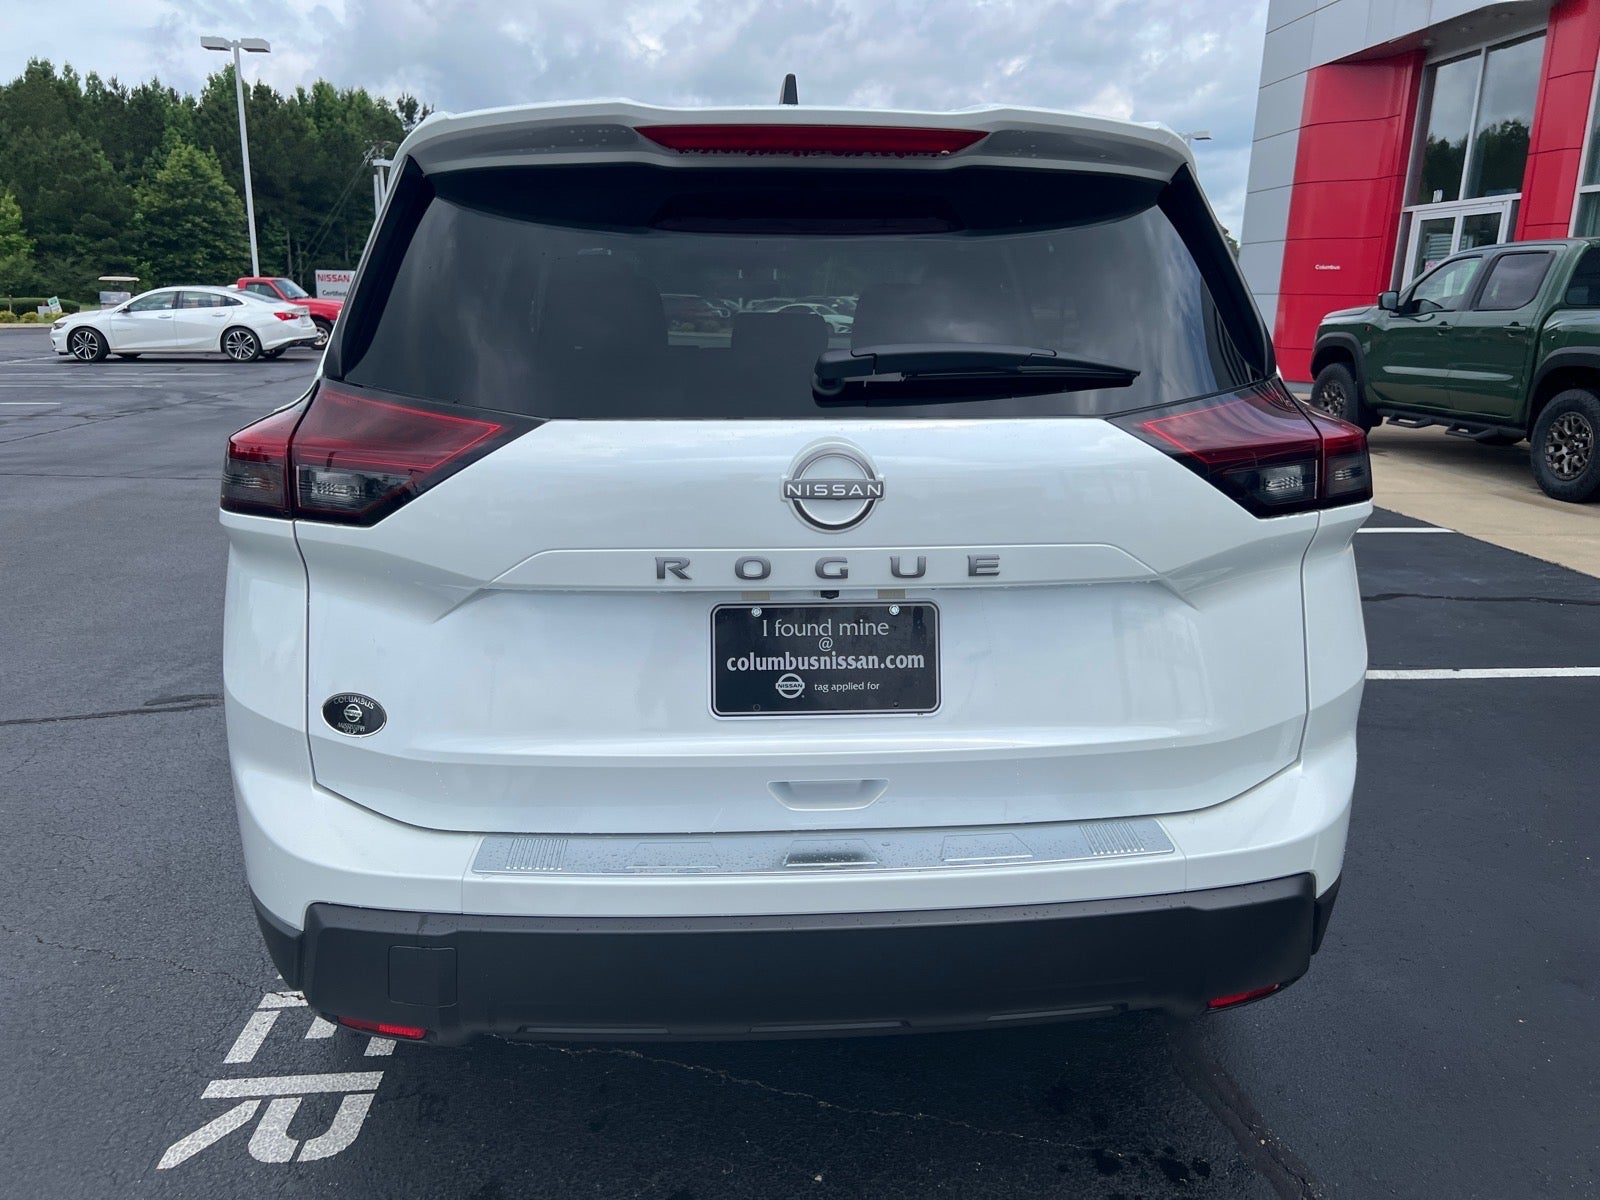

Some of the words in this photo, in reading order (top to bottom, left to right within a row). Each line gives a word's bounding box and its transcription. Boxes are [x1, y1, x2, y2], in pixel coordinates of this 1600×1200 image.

[317, 273, 350, 283] NISSAN
[786, 483, 882, 497] NISSAN
[654, 553, 1001, 581] ROGUE
[762, 619, 769, 637] I
[774, 618, 832, 637] found
[838, 618, 890, 636] mine
[818, 636, 834, 652] @
[726, 651, 925, 672] columbusnissan.com
[777, 682, 803, 690] NISSAN
[814, 682, 829, 693] tag
[830, 681, 865, 692] applied
[866, 681, 880, 691] for
[333, 695, 375, 710] COLUMBUS
